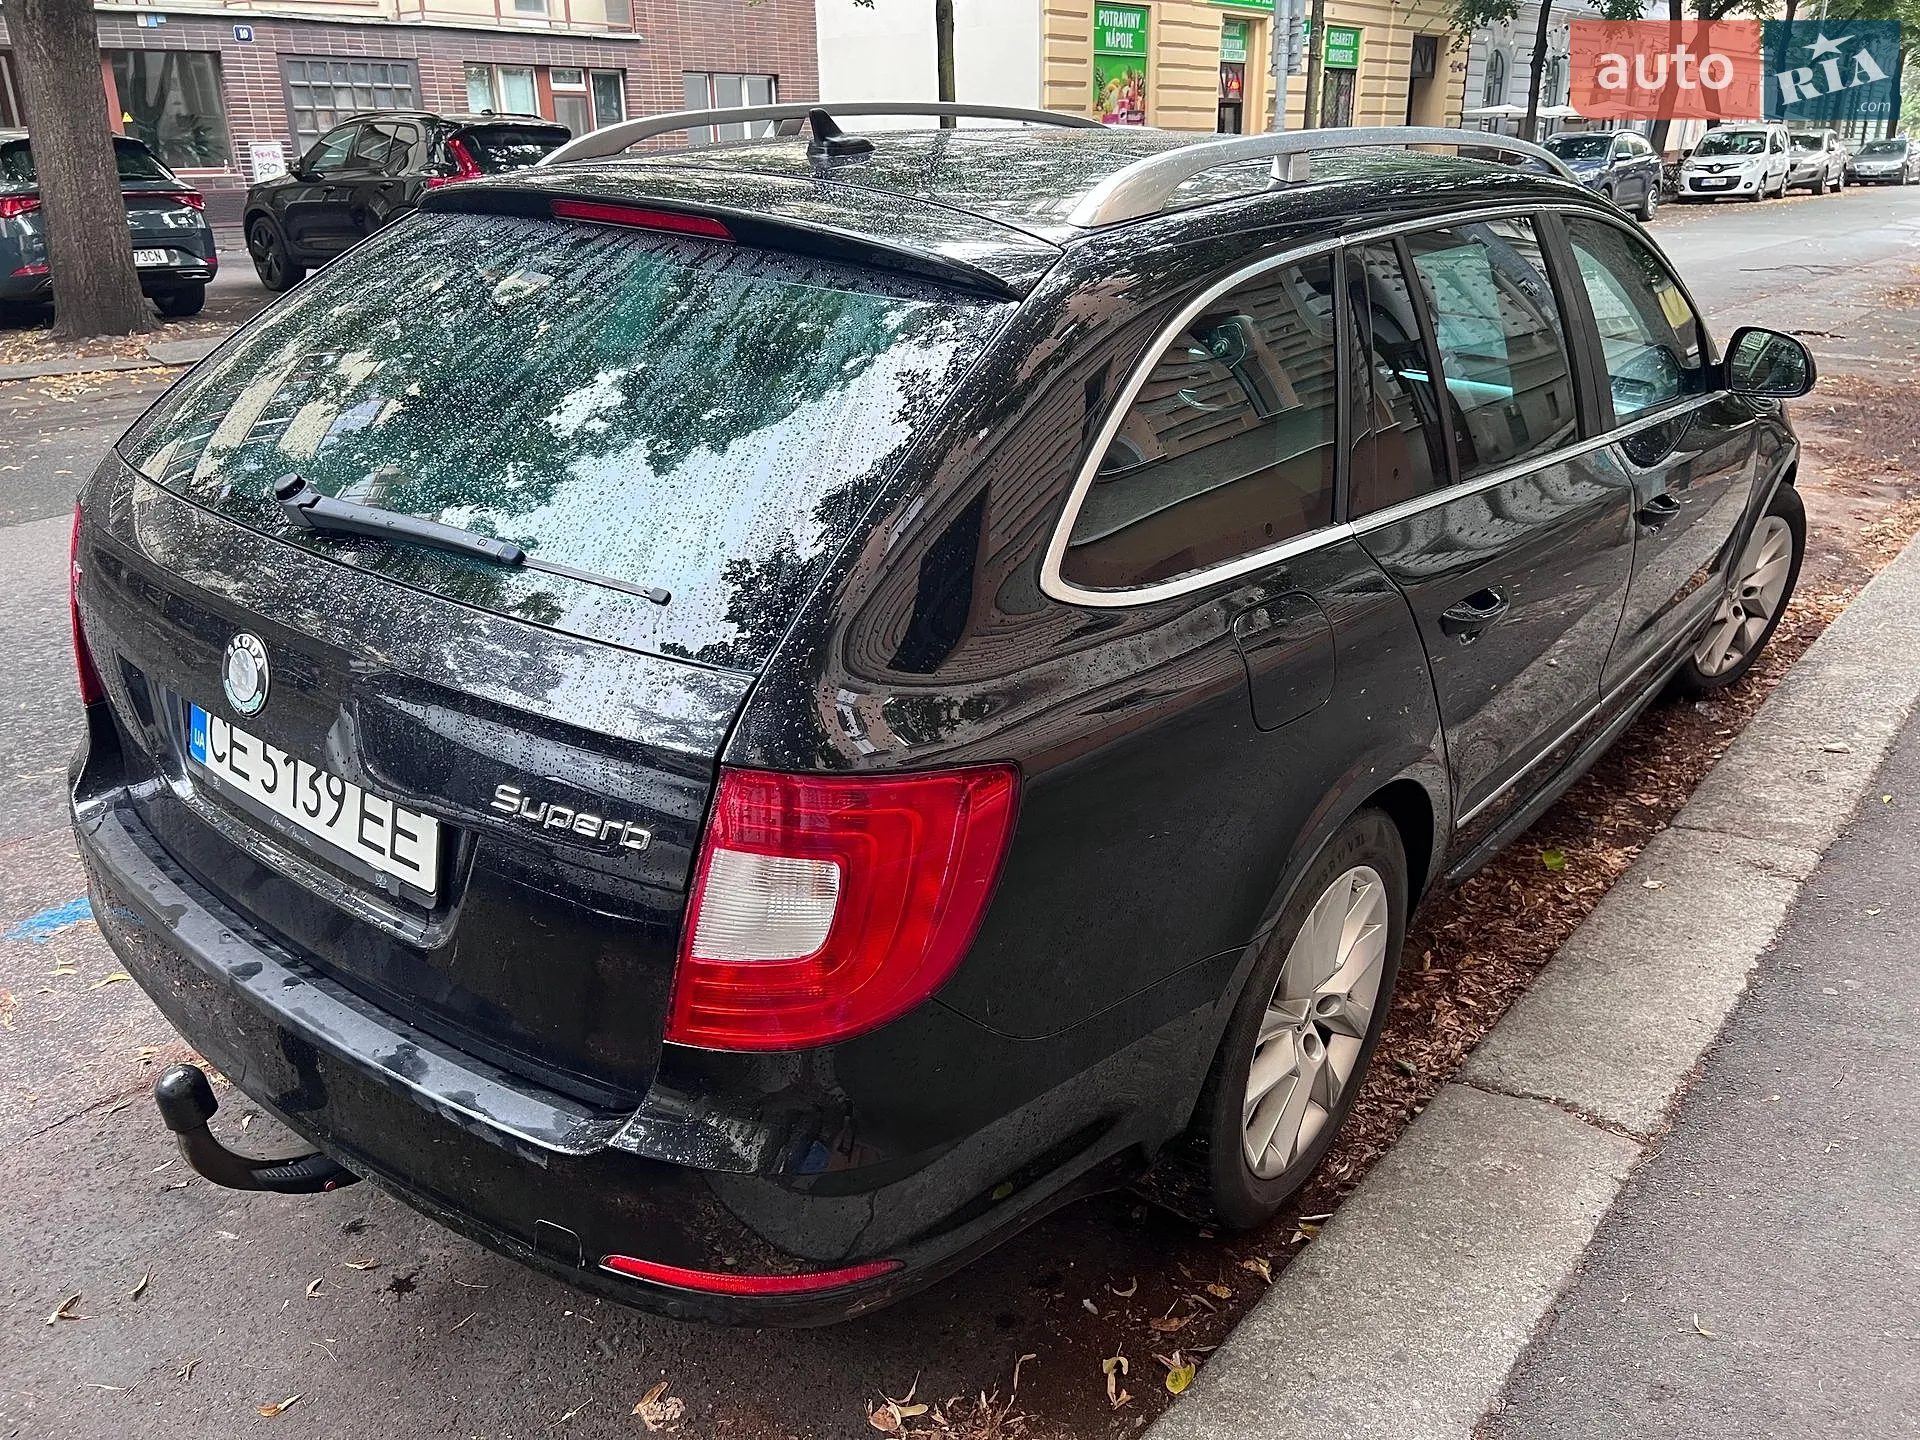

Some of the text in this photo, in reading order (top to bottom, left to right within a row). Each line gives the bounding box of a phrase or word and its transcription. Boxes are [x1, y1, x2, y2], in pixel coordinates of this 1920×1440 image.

[1099, 10, 1141, 29] POTRAVINY
[239, 28, 249, 39] 10
[1105, 28, 1133, 48] NÁPOJE
[1329, 32, 1354, 46] CIGARETY
[132, 250, 163, 262] 73CN
[194, 729, 205, 748] UA
[209, 715, 250, 782] CE
[358, 788, 422, 872] EE
[490, 784, 651, 850] Superb
